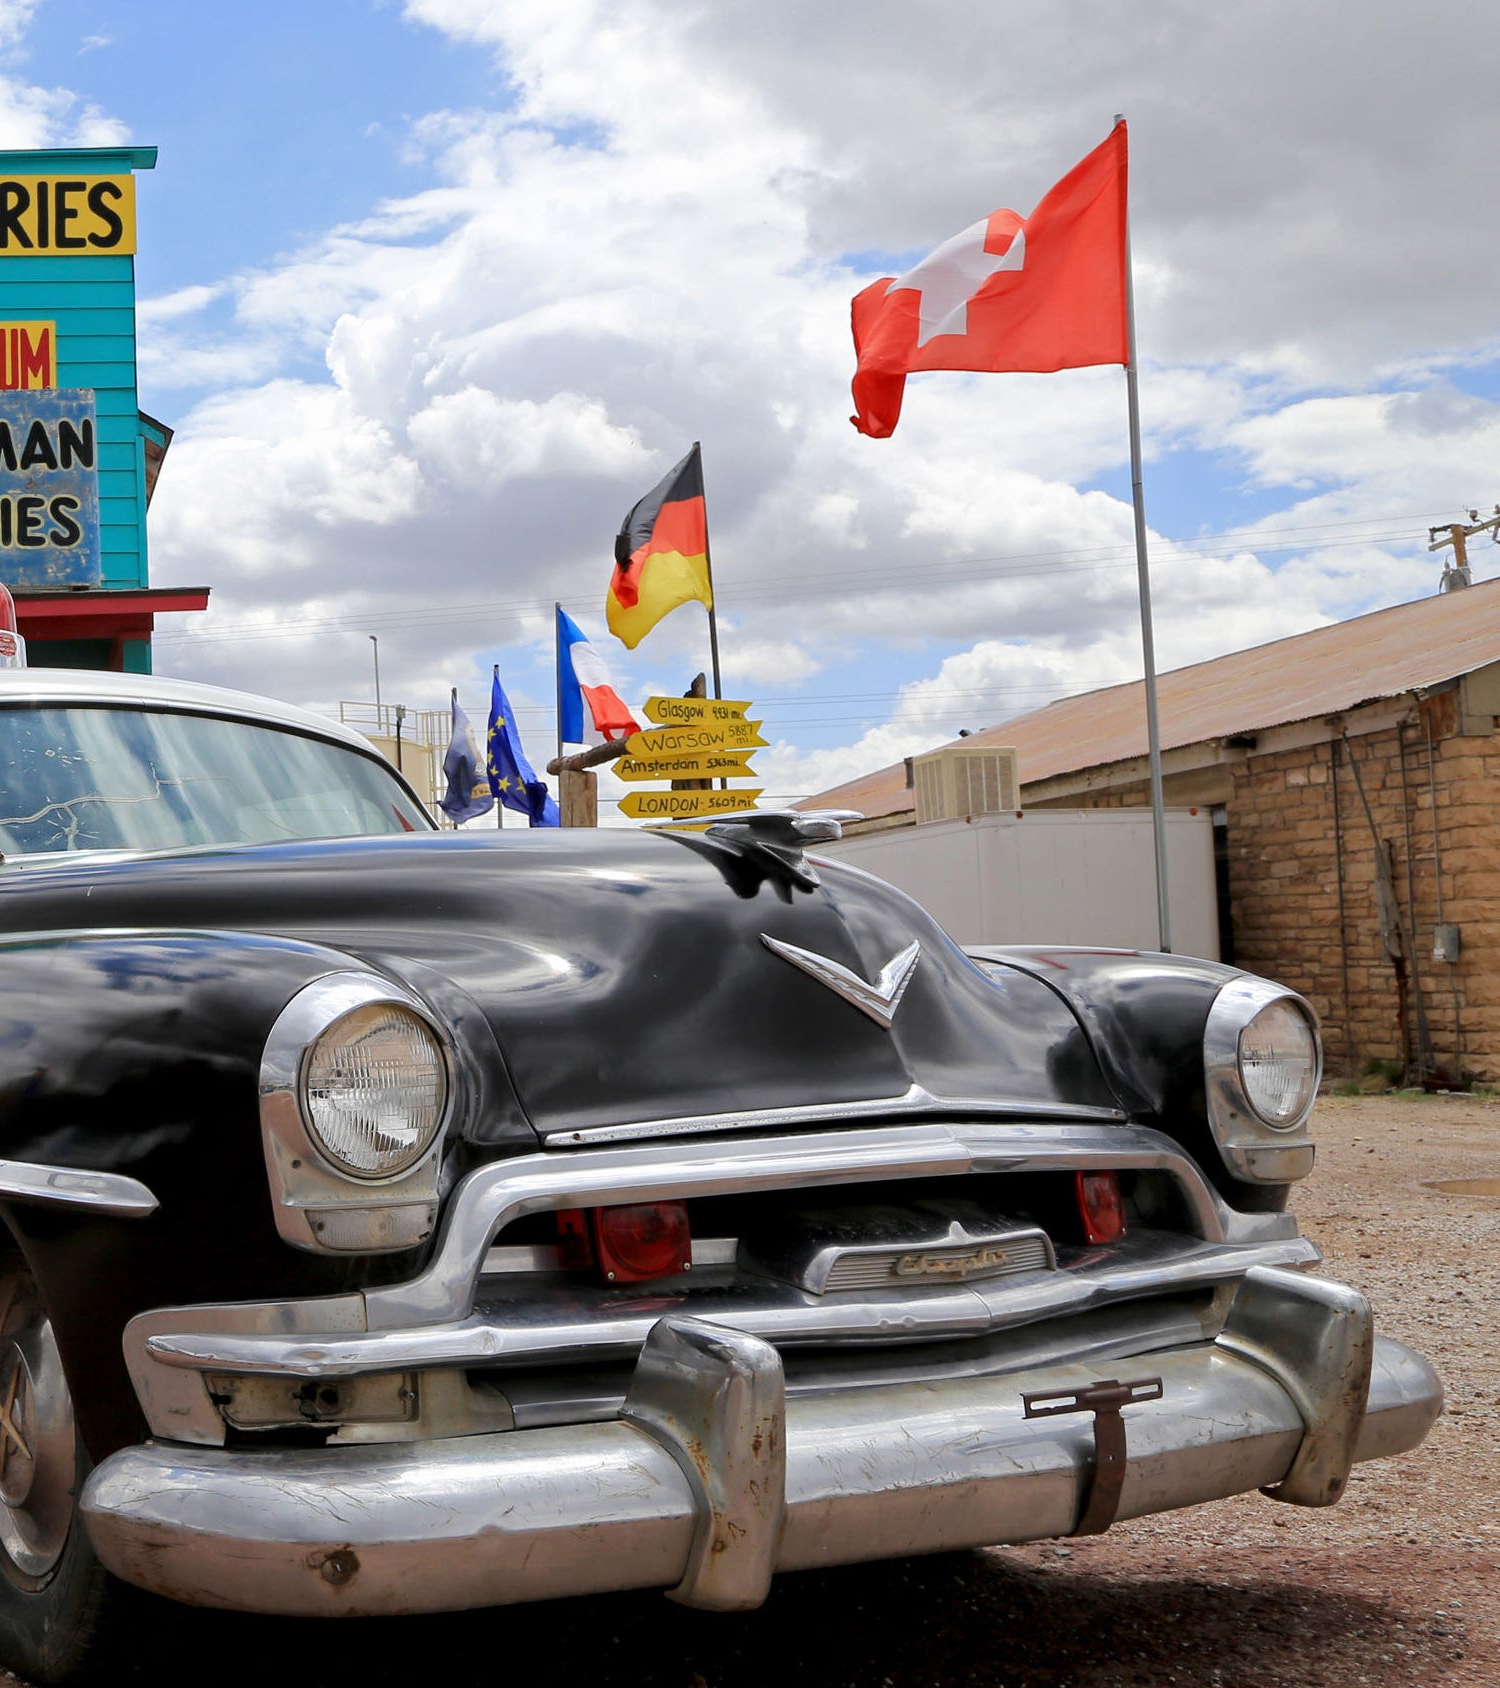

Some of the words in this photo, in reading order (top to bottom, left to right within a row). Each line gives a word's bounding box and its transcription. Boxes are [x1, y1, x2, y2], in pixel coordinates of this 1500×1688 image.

[642, 731, 725, 752] Warsaw
[621, 759, 699, 774] Amsterdam
[708, 796, 736, 808] 5609
